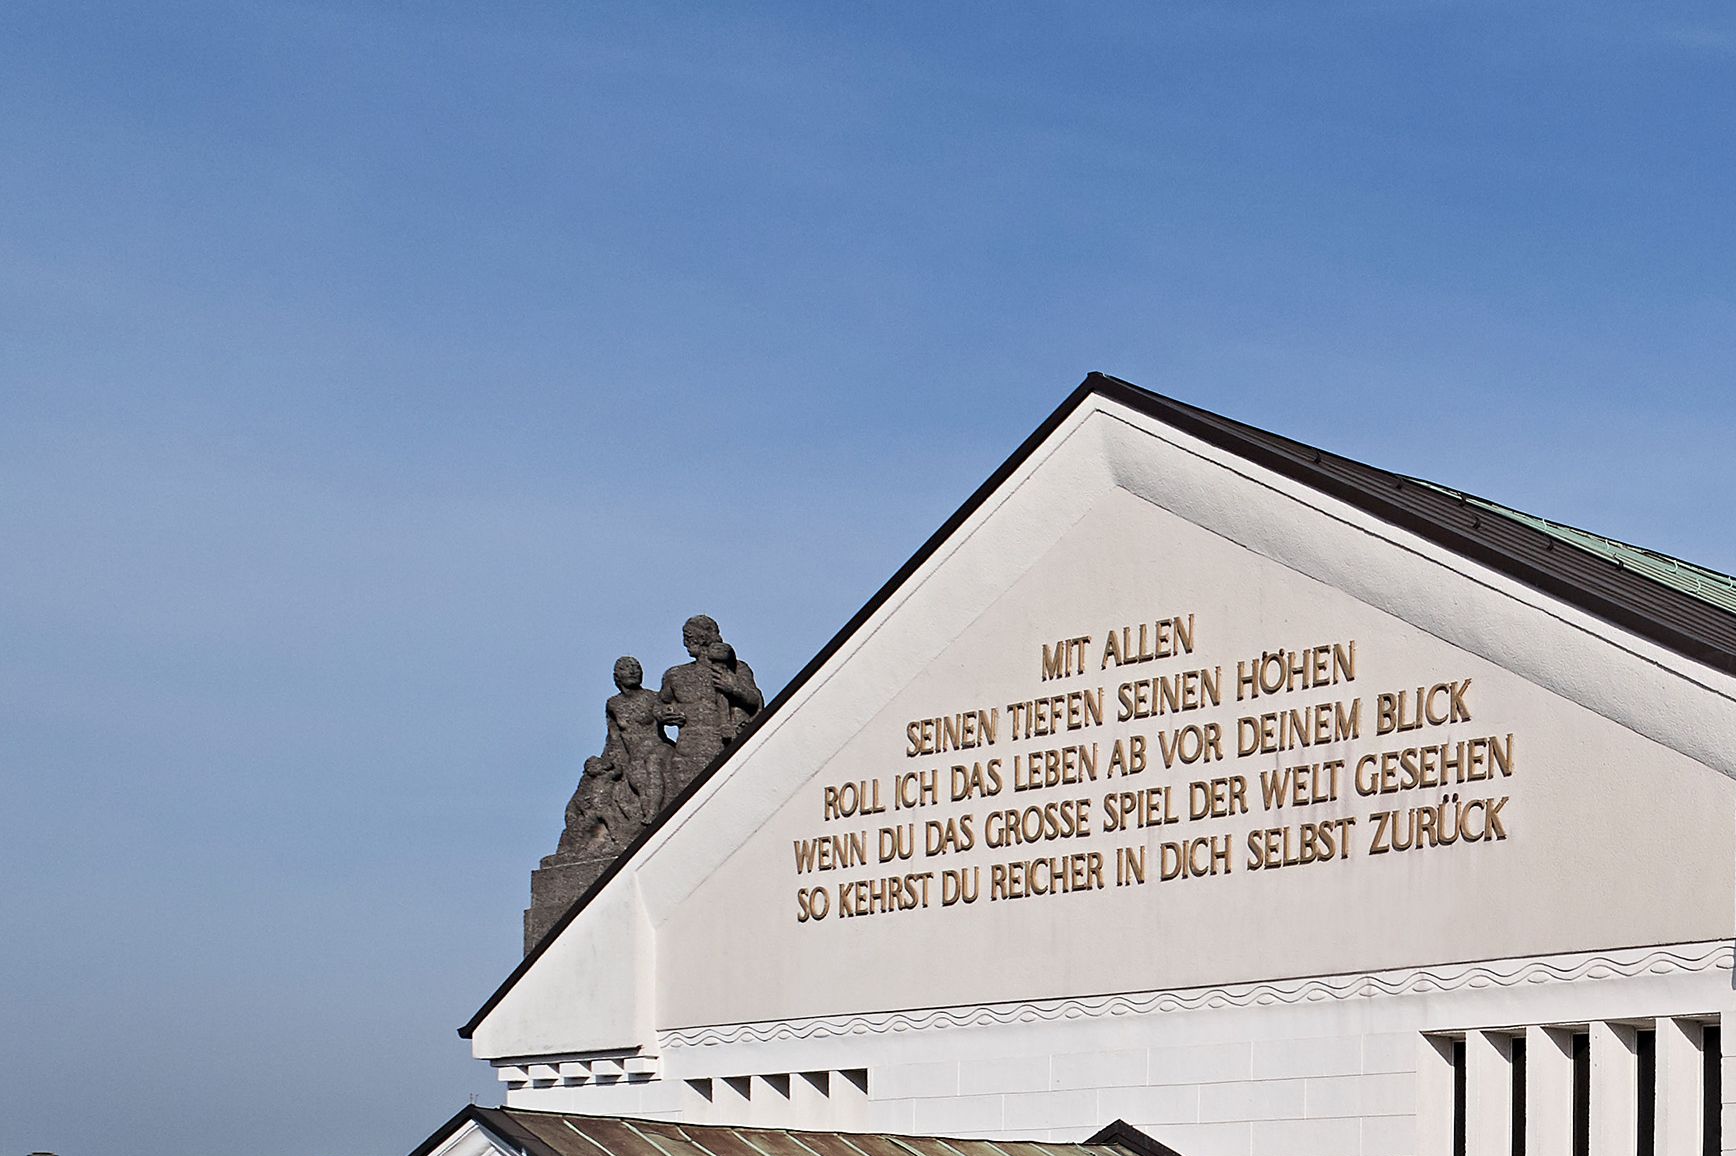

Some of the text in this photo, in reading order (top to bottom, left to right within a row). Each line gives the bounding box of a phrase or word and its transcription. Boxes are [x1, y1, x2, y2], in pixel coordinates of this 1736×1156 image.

[906, 640, 1356, 758] SEINEN TIEFEN SEINEN HÖHEN
[1041, 613, 1195, 682] MIT ALLEN
[793, 734, 1514, 875] WENN DU DAS GROSSE SPIEL DER WELT GESEHEN
[824, 678, 1472, 821] ROLL ICH DAS LEBEN AB VOR DEINEM BLICK
[797, 793, 1510, 923] SO KEHRST DU REICHER IN DICH SELBST ZURÜCK
